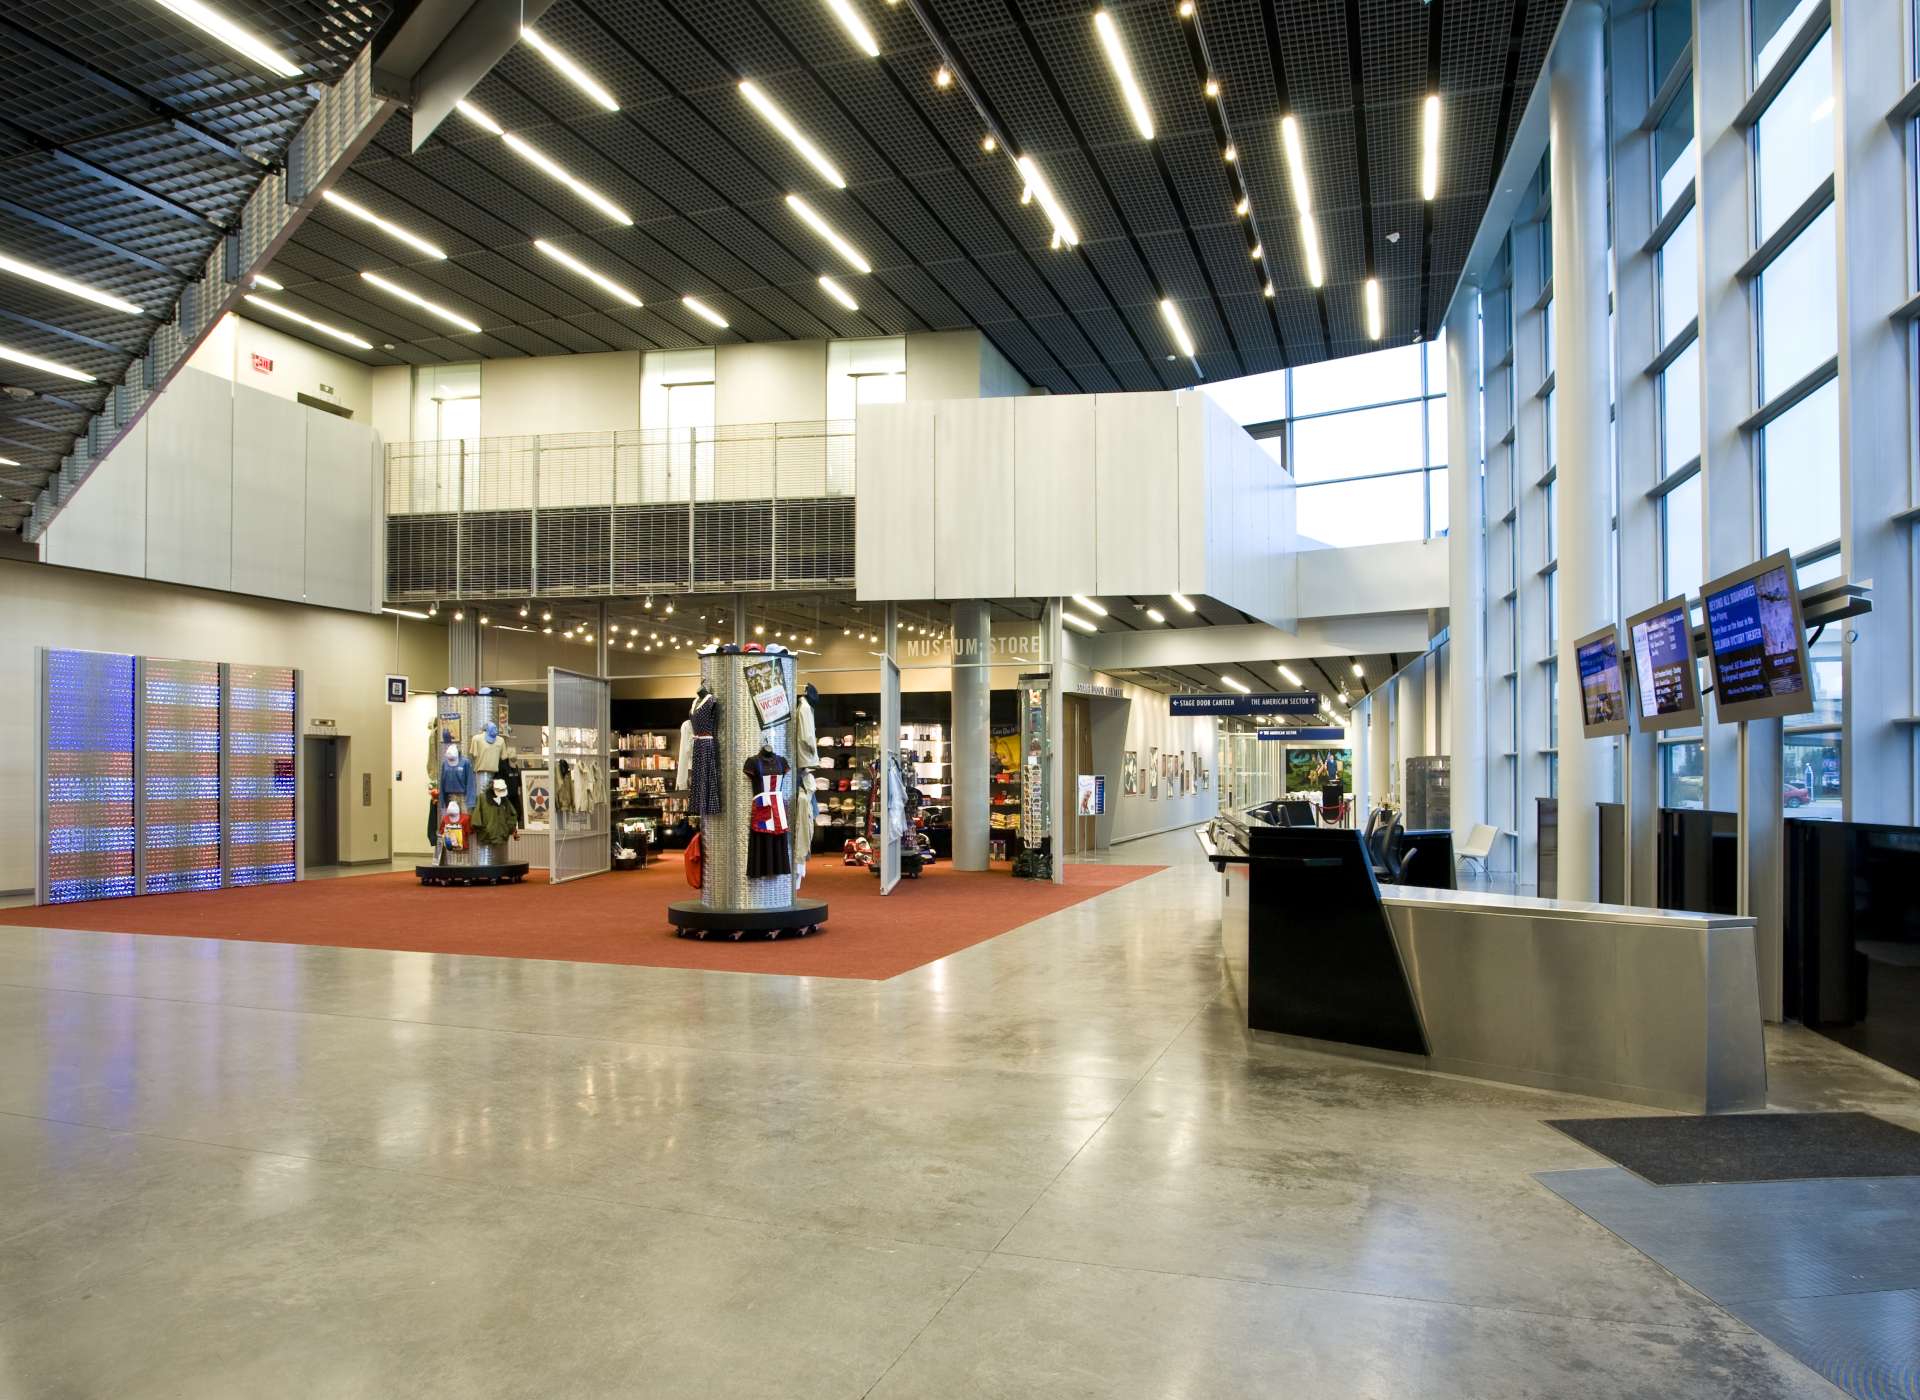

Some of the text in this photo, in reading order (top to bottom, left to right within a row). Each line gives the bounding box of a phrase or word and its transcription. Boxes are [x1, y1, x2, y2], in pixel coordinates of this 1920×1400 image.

[907, 636, 1040, 657] MUSEUM STORE
[1179, 699, 1195, 707] STAGE
[1197, 699, 1211, 707] DOOR
[1251, 697, 1309, 706] THE AMERICAN SECTOR
